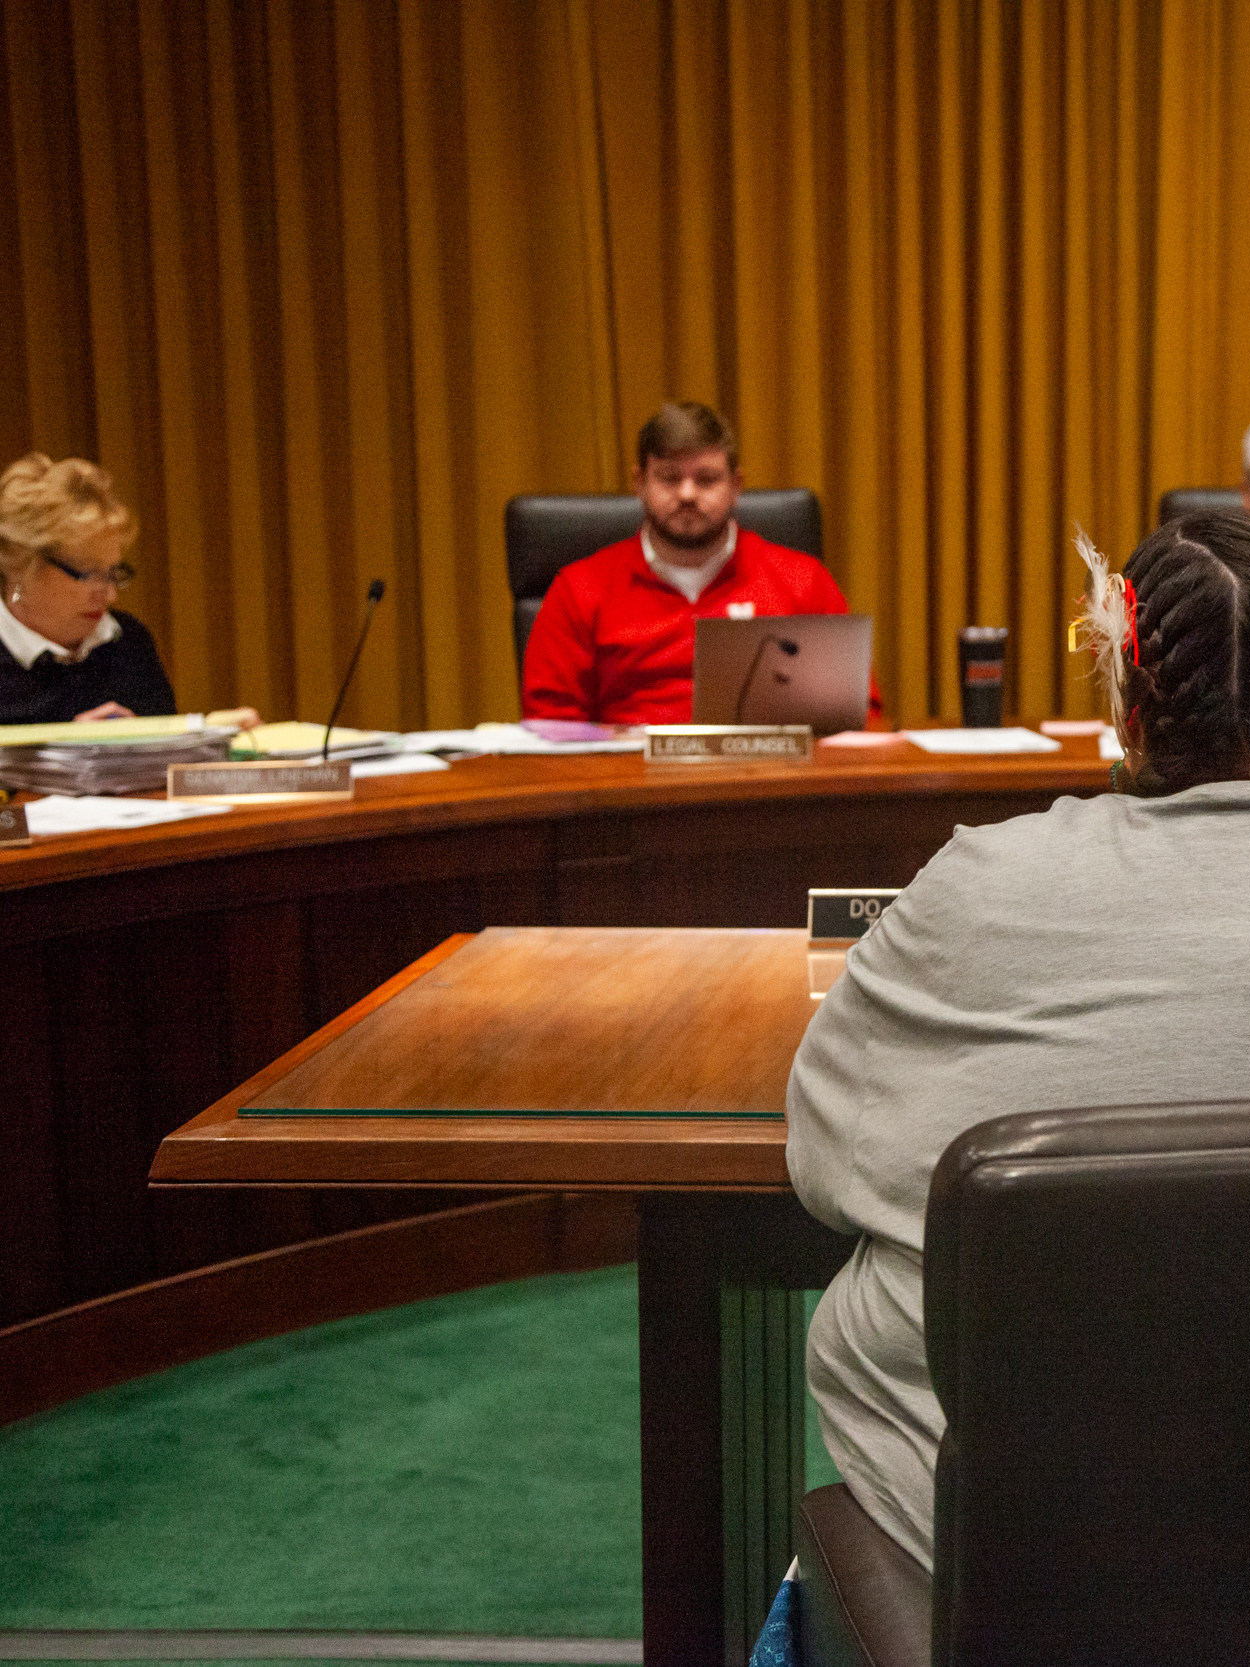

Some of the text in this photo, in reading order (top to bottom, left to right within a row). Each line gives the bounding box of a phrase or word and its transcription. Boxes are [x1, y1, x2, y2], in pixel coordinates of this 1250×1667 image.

[653, 736, 800, 755] LEGAL COUNSEL
[849, 898, 881, 919] DO
